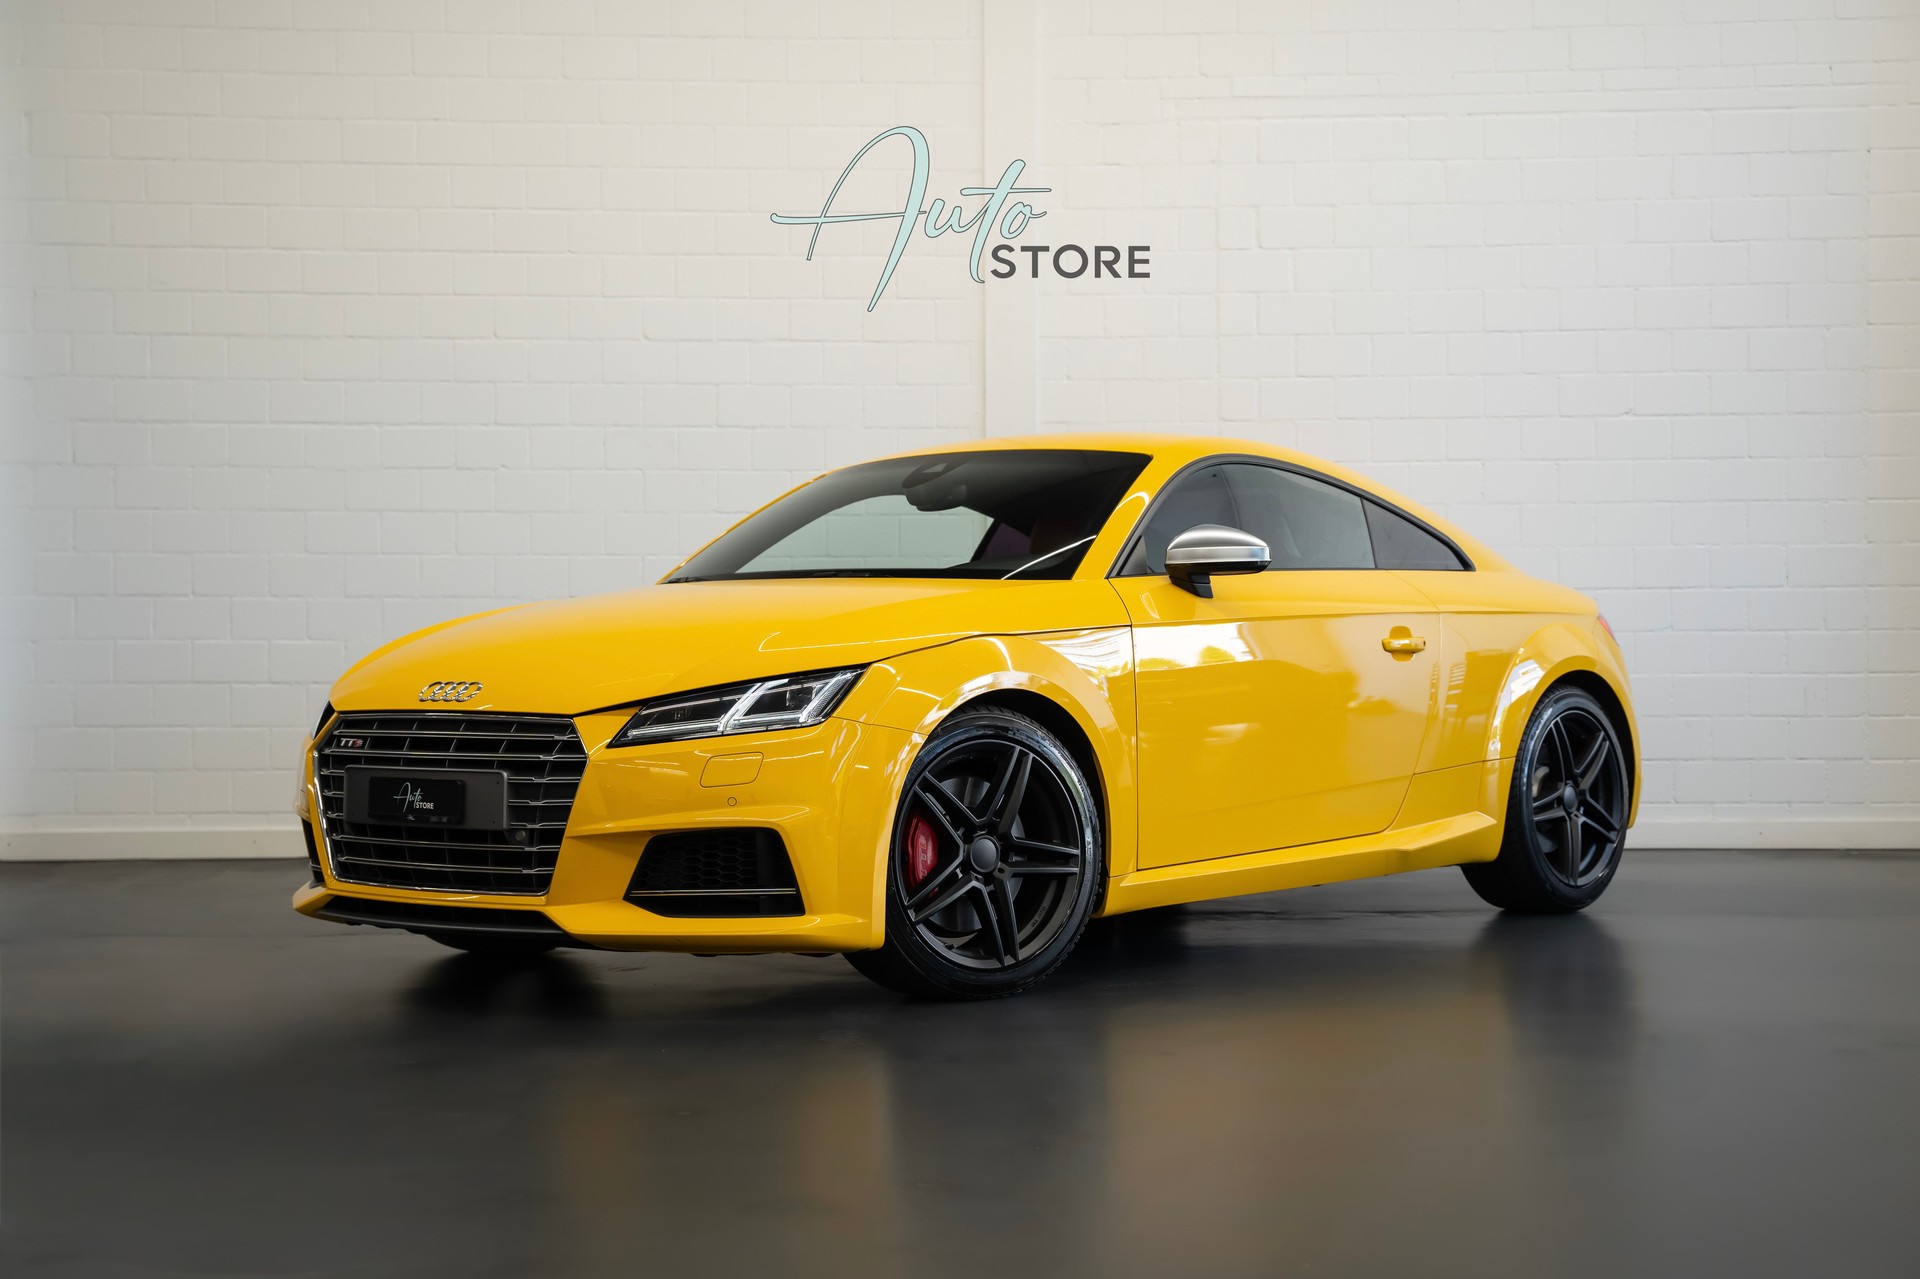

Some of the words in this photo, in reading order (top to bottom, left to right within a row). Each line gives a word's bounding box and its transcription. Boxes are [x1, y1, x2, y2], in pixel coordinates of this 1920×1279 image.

[769, 125, 1053, 313] Auto
[990, 243, 1151, 280] STORE
[340, 737, 363, 747] TTS
[393, 781, 424, 813] Auto
[415, 801, 434, 810] STORE
